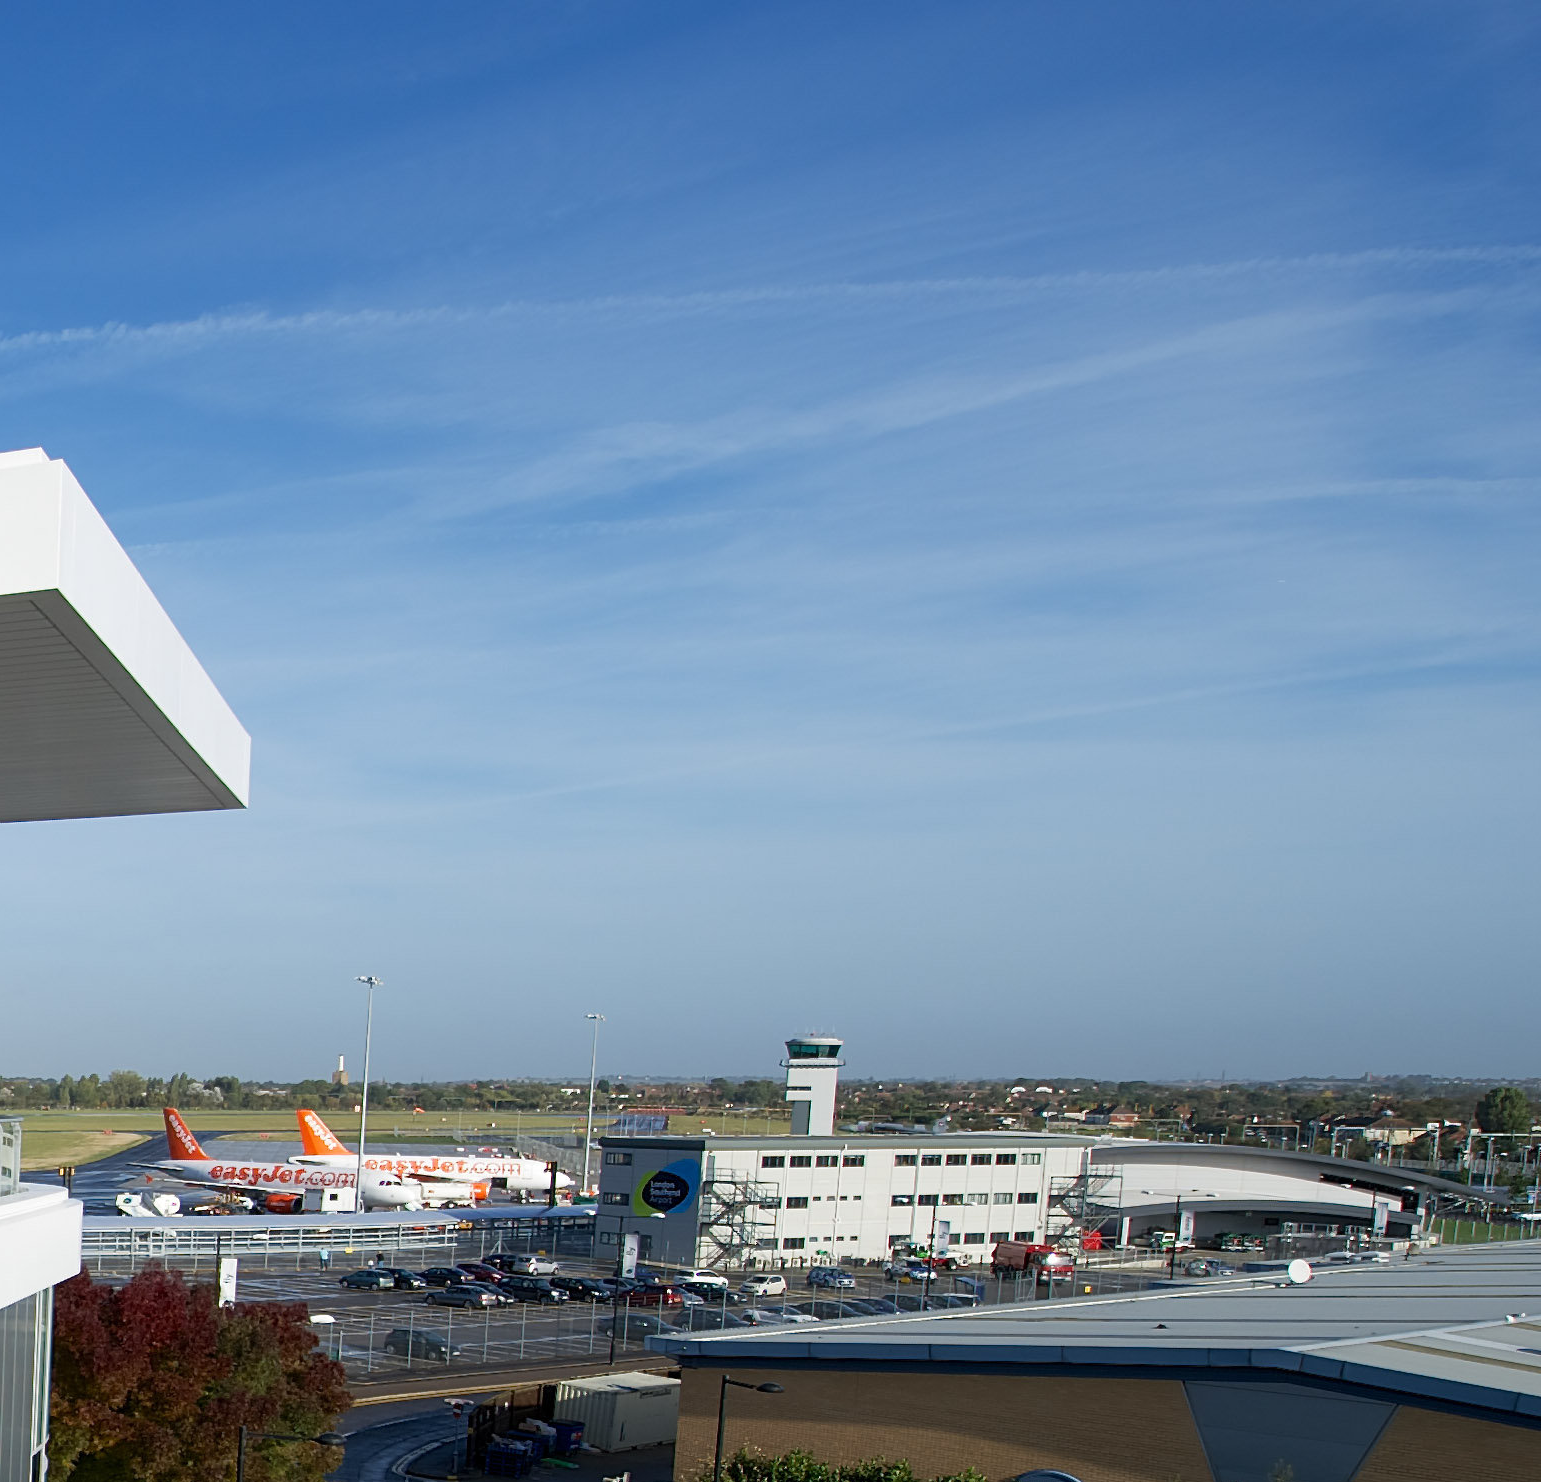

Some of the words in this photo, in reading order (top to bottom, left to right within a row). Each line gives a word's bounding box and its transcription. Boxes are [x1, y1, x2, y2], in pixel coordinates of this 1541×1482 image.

[168, 1114, 196, 1154] easyJet
[304, 1114, 337, 1151] easyJet
[209, 1165, 356, 1188] easyJet.com
[365, 1157, 521, 1179] easyJet.com
